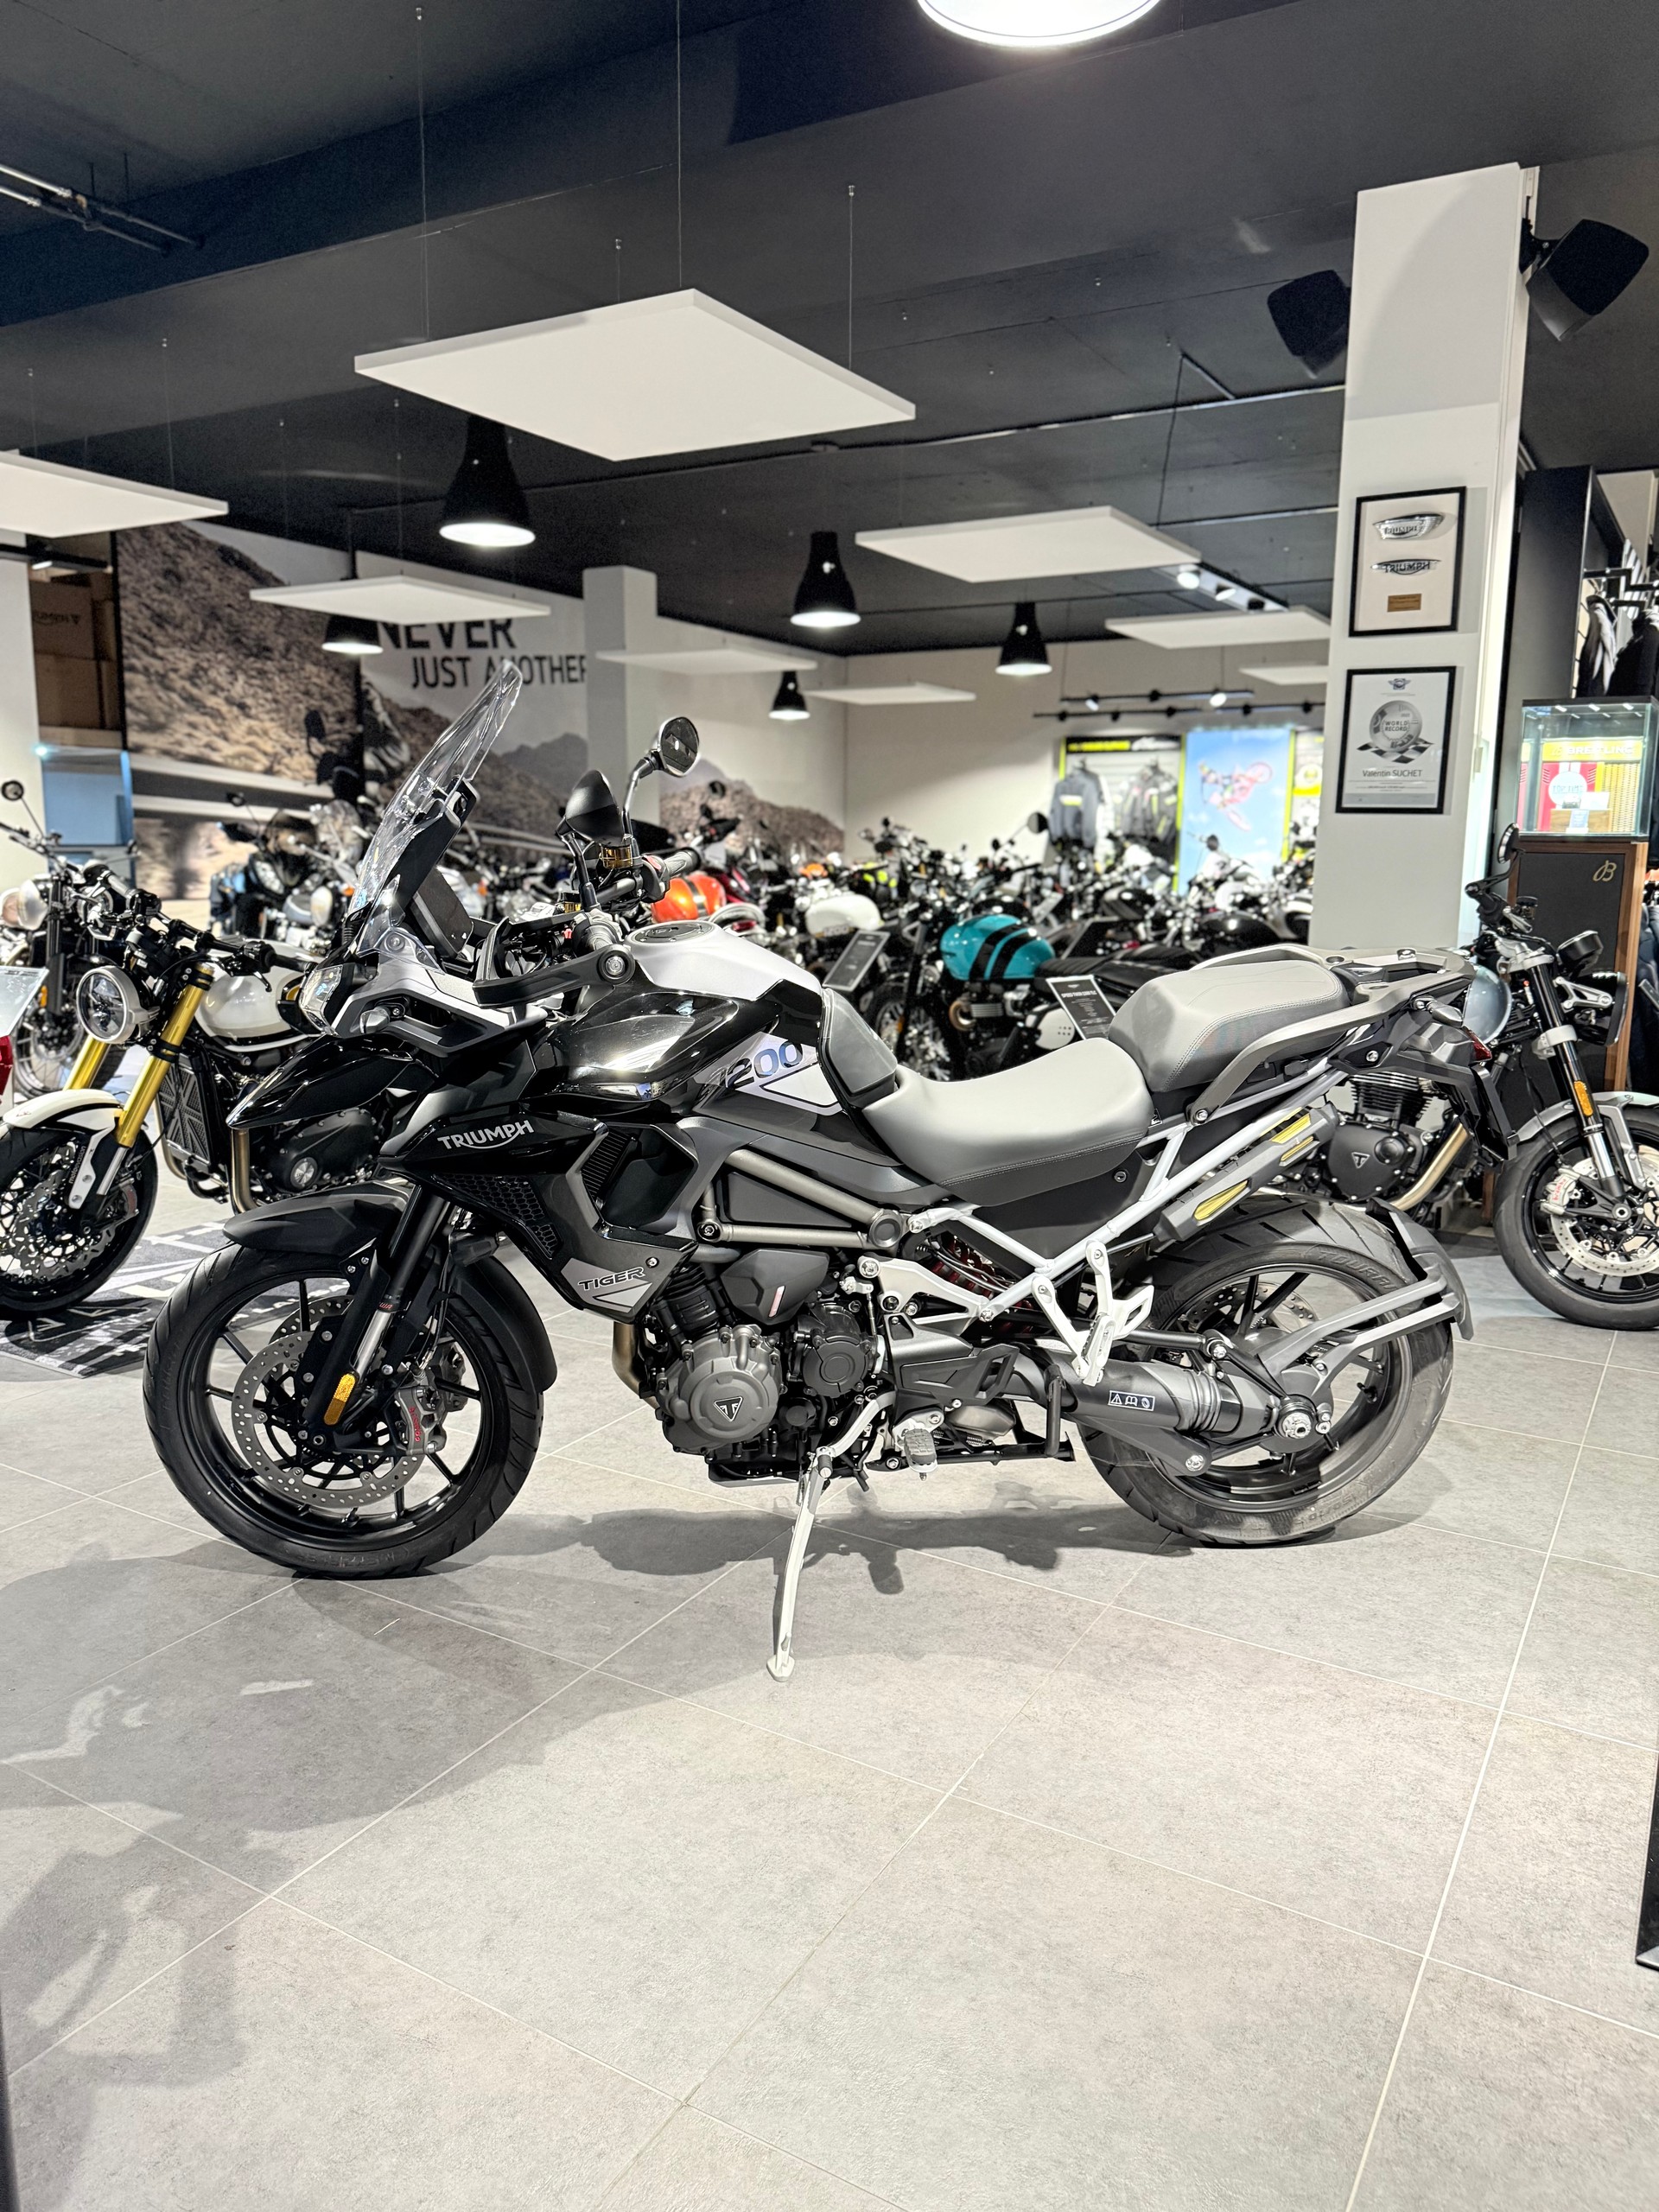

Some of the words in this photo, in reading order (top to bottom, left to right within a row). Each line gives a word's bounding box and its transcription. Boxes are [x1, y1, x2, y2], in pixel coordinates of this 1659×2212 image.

[1383, 562, 1430, 573] TRIUMPH
[411, 655, 471, 689] JUST
[484, 653, 586, 685] AOTHE
[1363, 769, 1391, 778] Valentin
[1392, 769, 1423, 778] SUCHET
[437, 1120, 534, 1149] TRIUMPH
[578, 1267, 645, 1291] TIGER
